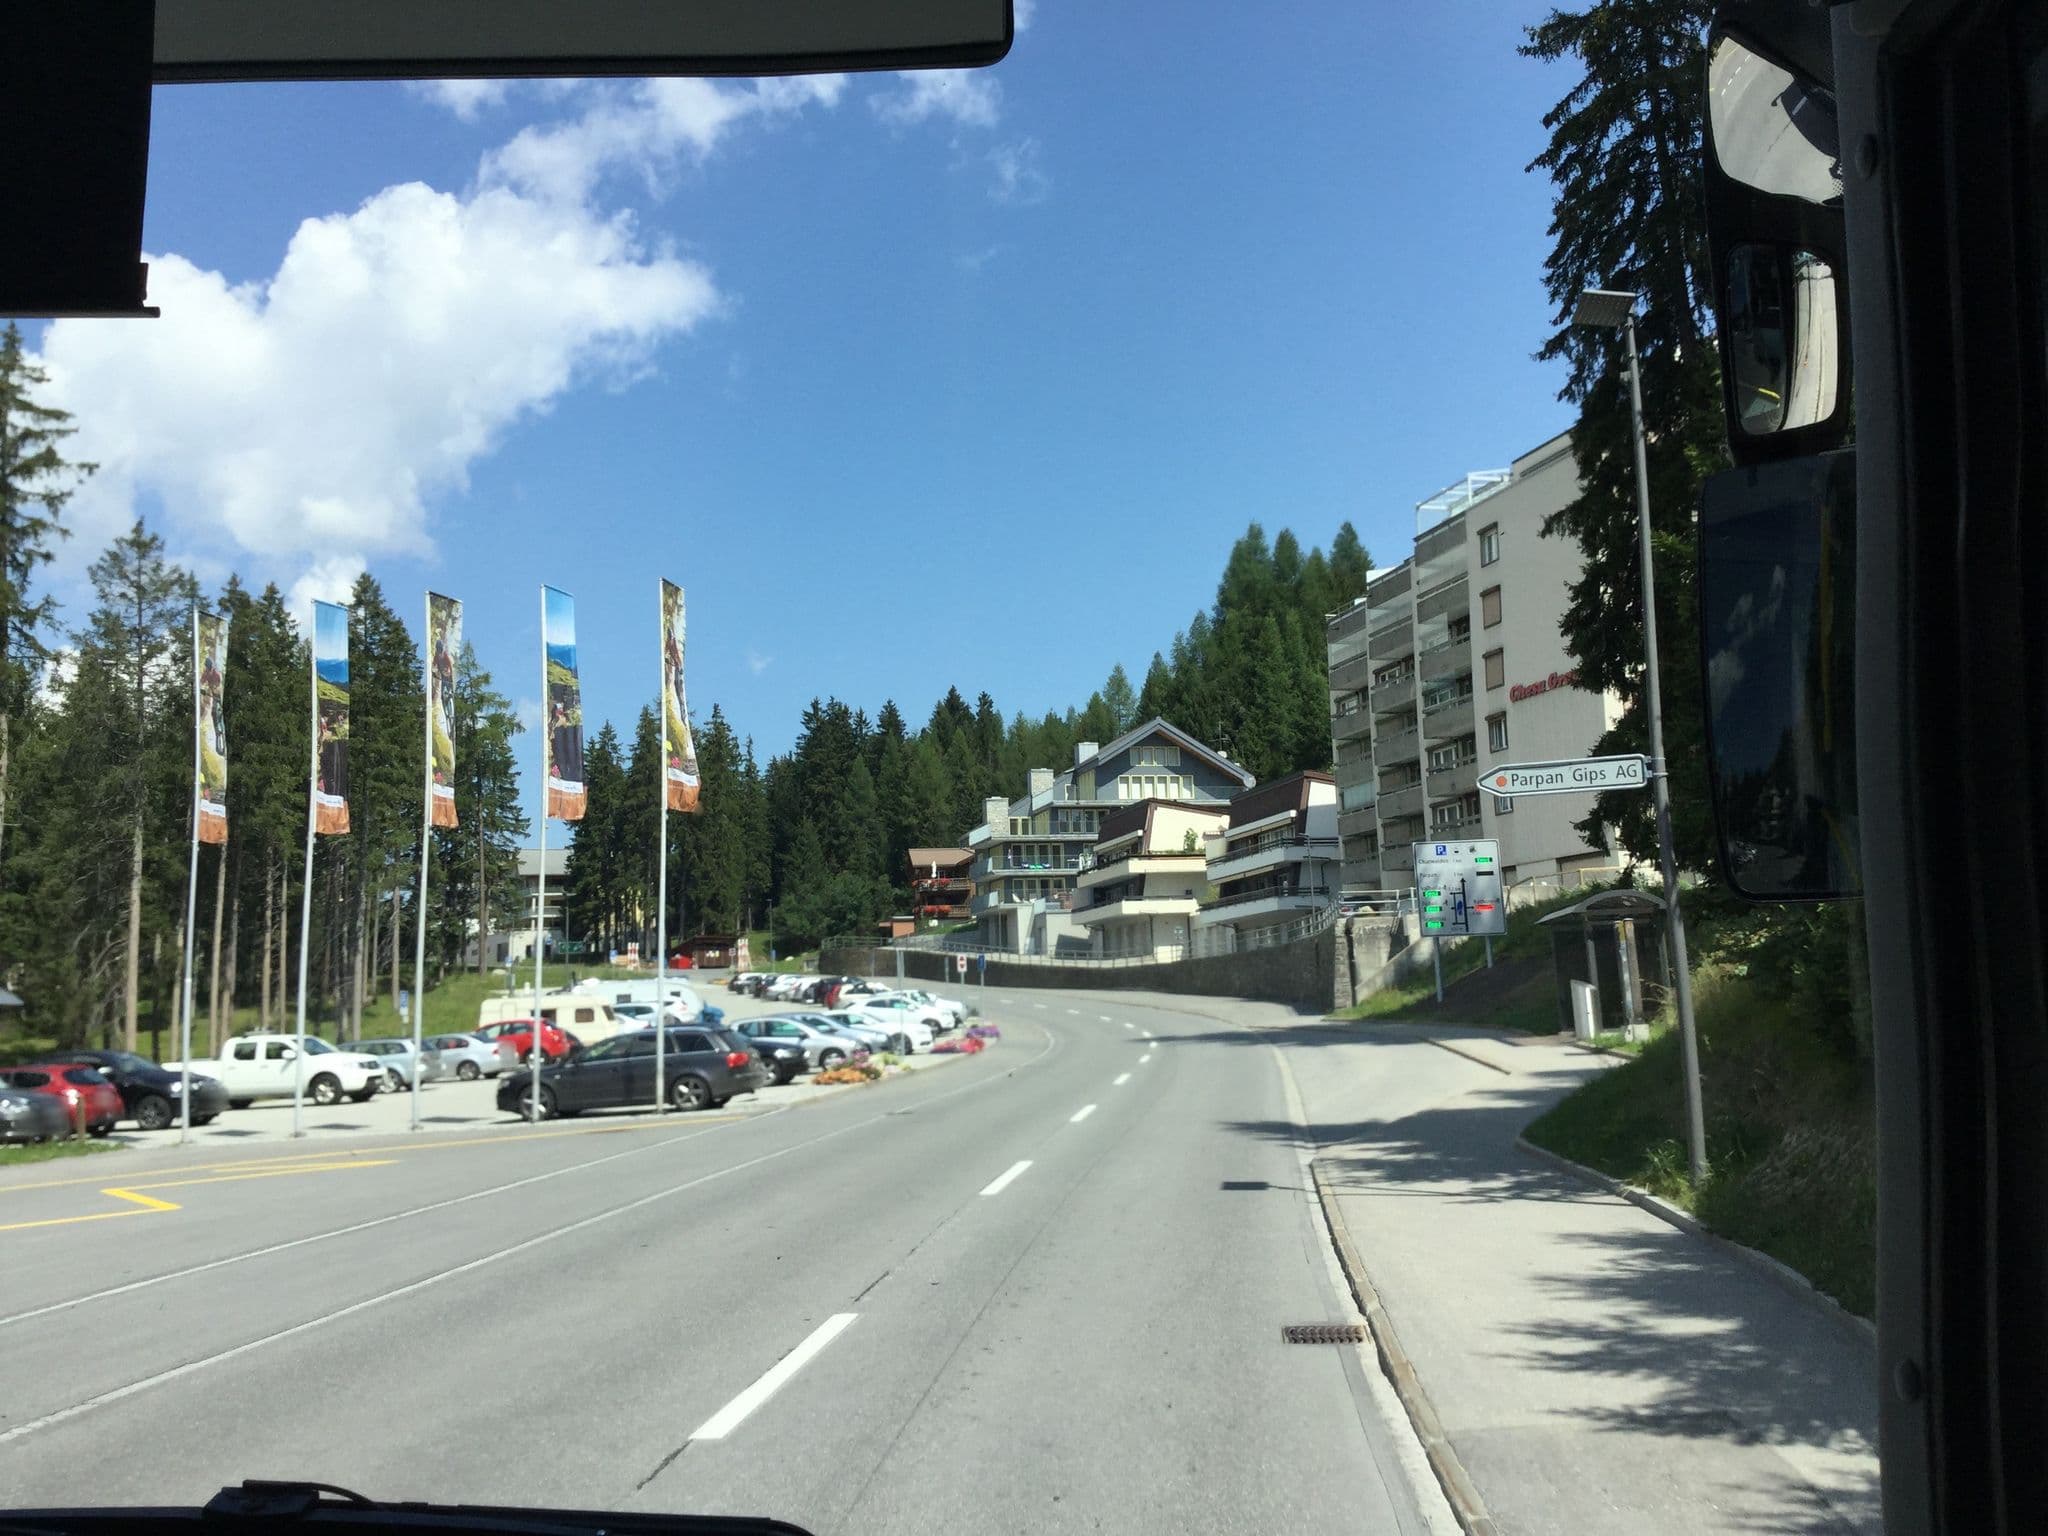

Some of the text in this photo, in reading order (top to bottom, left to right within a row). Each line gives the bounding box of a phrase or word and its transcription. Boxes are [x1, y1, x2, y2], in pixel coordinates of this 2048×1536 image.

[1511, 764, 1637, 788] Parpan Gips AG
